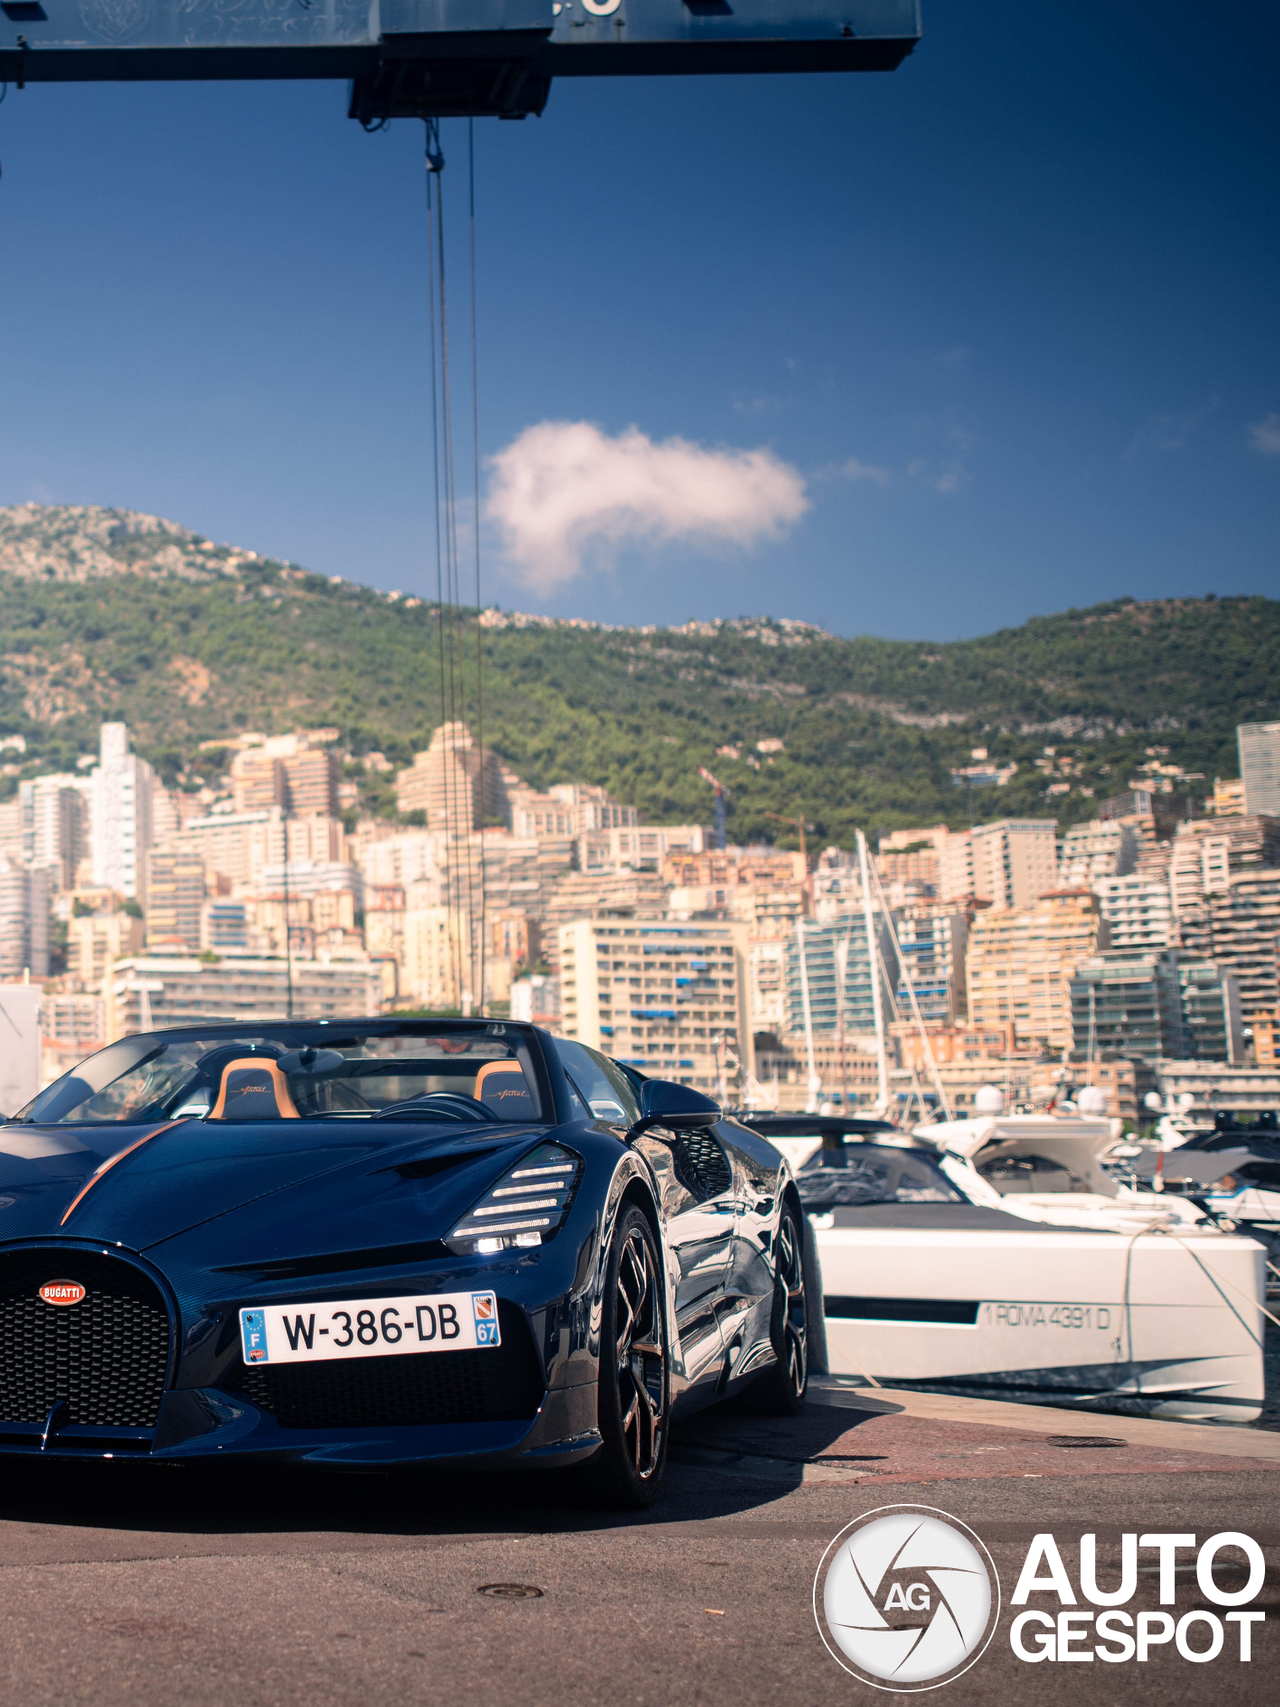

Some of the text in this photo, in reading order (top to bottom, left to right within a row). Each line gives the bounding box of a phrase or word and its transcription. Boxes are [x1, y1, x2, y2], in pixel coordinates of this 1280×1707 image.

[44, 1287, 80, 1298] BUGATTI
[996, 1305, 1047, 1327] ROMA
[1097, 1308, 1111, 1329] D
[282, 1304, 461, 1351] W-386-DB
[477, 1323, 496, 1342] 67
[251, 1334, 260, 1347] F
